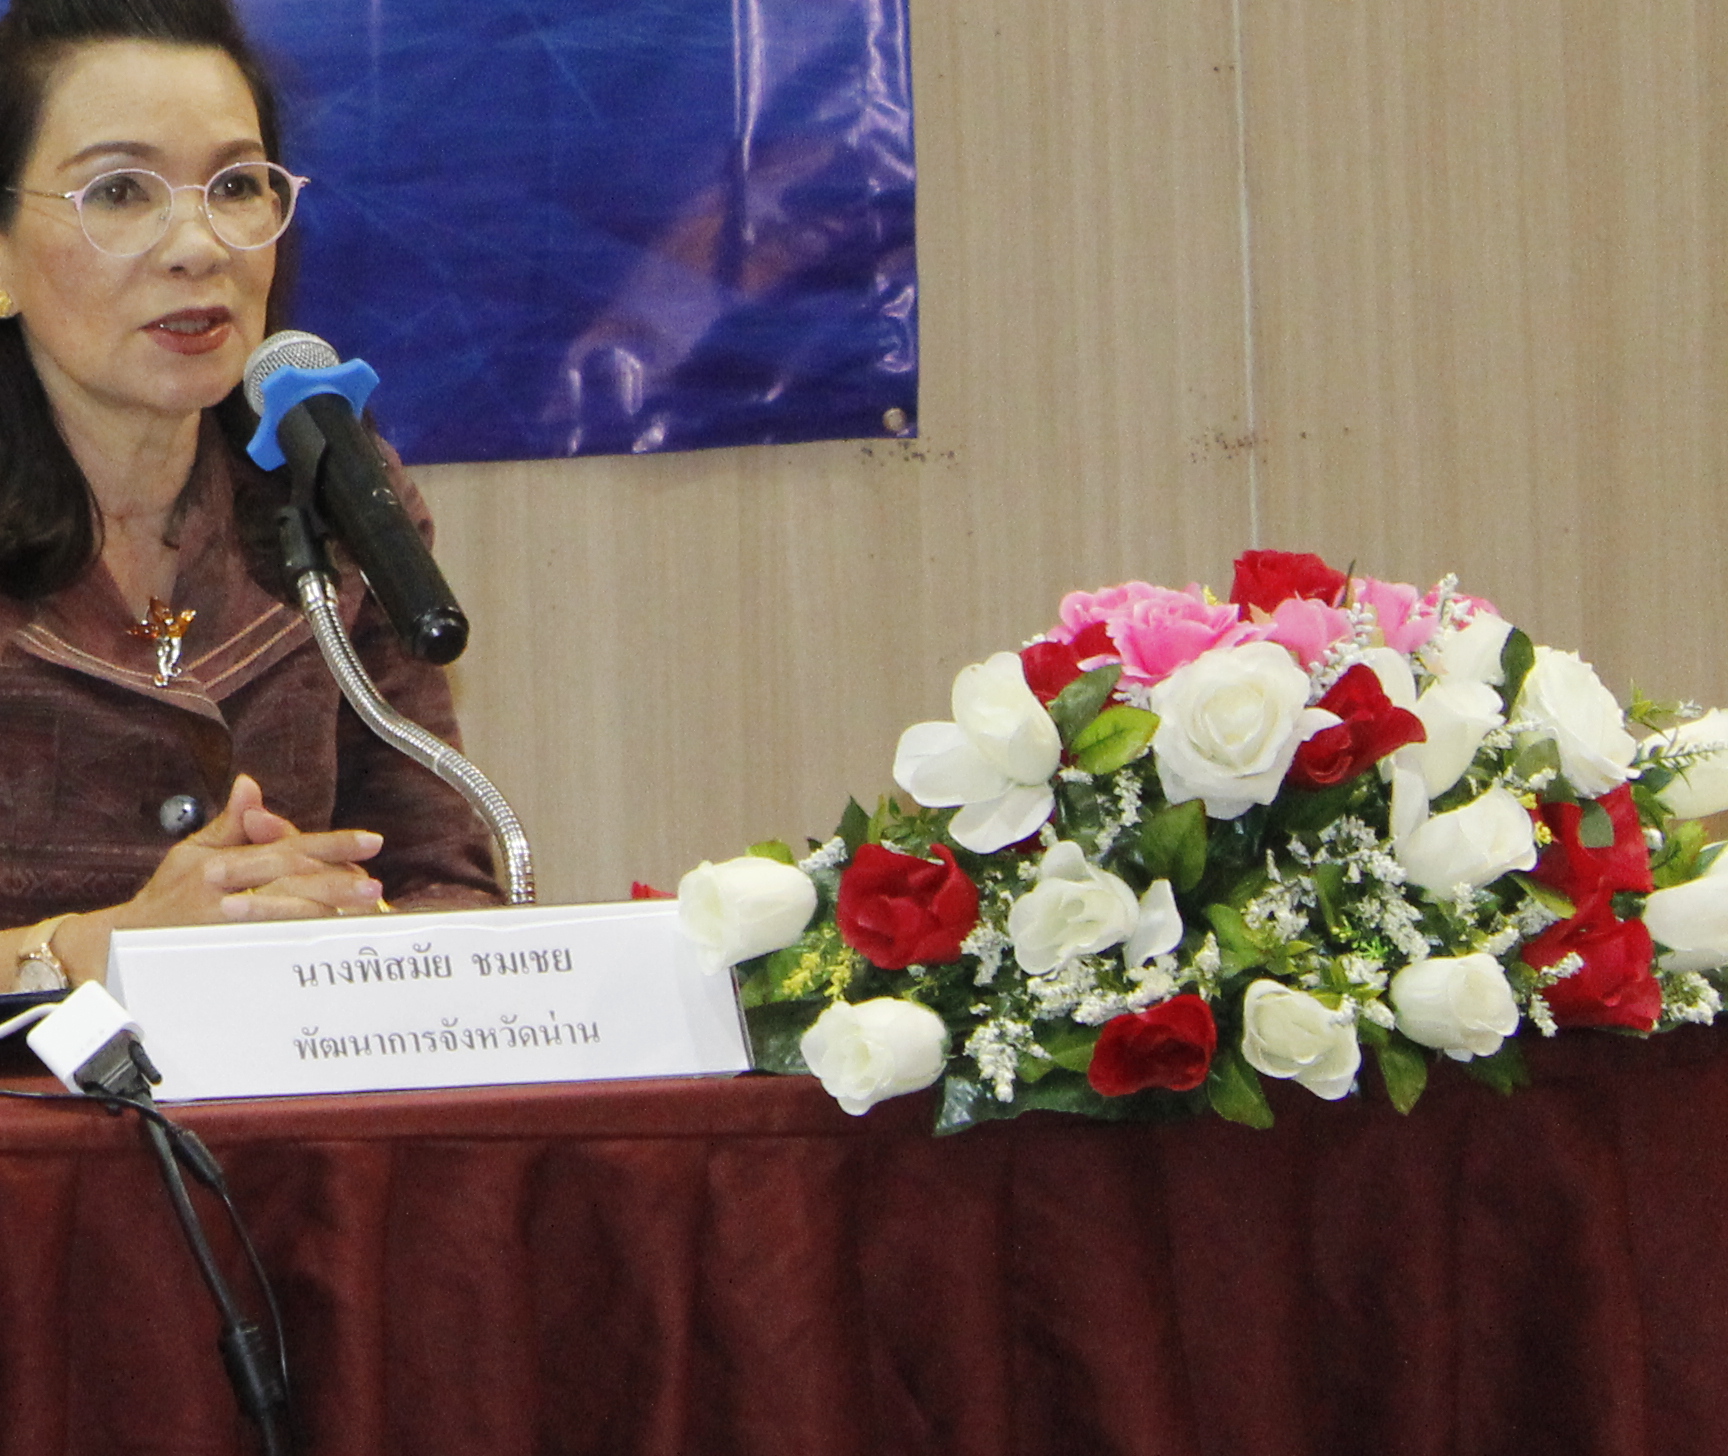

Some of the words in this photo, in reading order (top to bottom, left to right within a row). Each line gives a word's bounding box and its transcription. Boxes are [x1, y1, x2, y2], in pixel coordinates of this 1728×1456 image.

[293, 942, 452, 987] นางพิสมัย
[472, 948, 573, 976] ชมเชย
[293, 1011, 601, 1060] พัฒนาการจังหวัดน่าน
